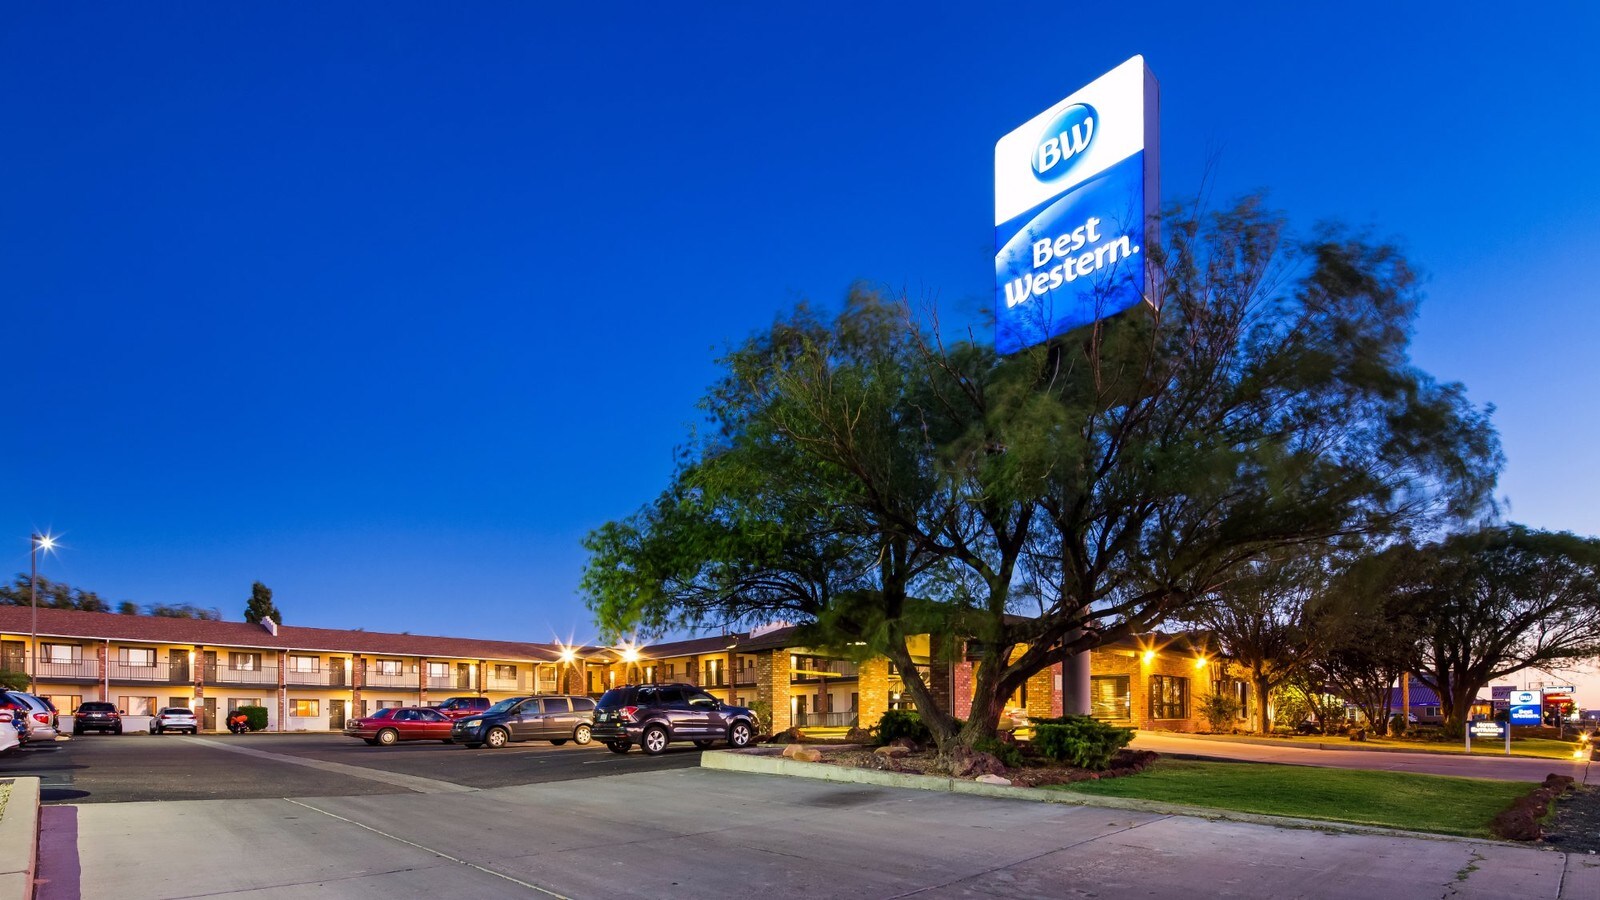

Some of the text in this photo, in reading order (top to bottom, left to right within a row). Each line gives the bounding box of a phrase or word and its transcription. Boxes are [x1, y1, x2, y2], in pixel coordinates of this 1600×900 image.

[1037, 116, 1094, 174] BW
[1004, 234, 1140, 309] Western.
[1033, 216, 1102, 269] Best
